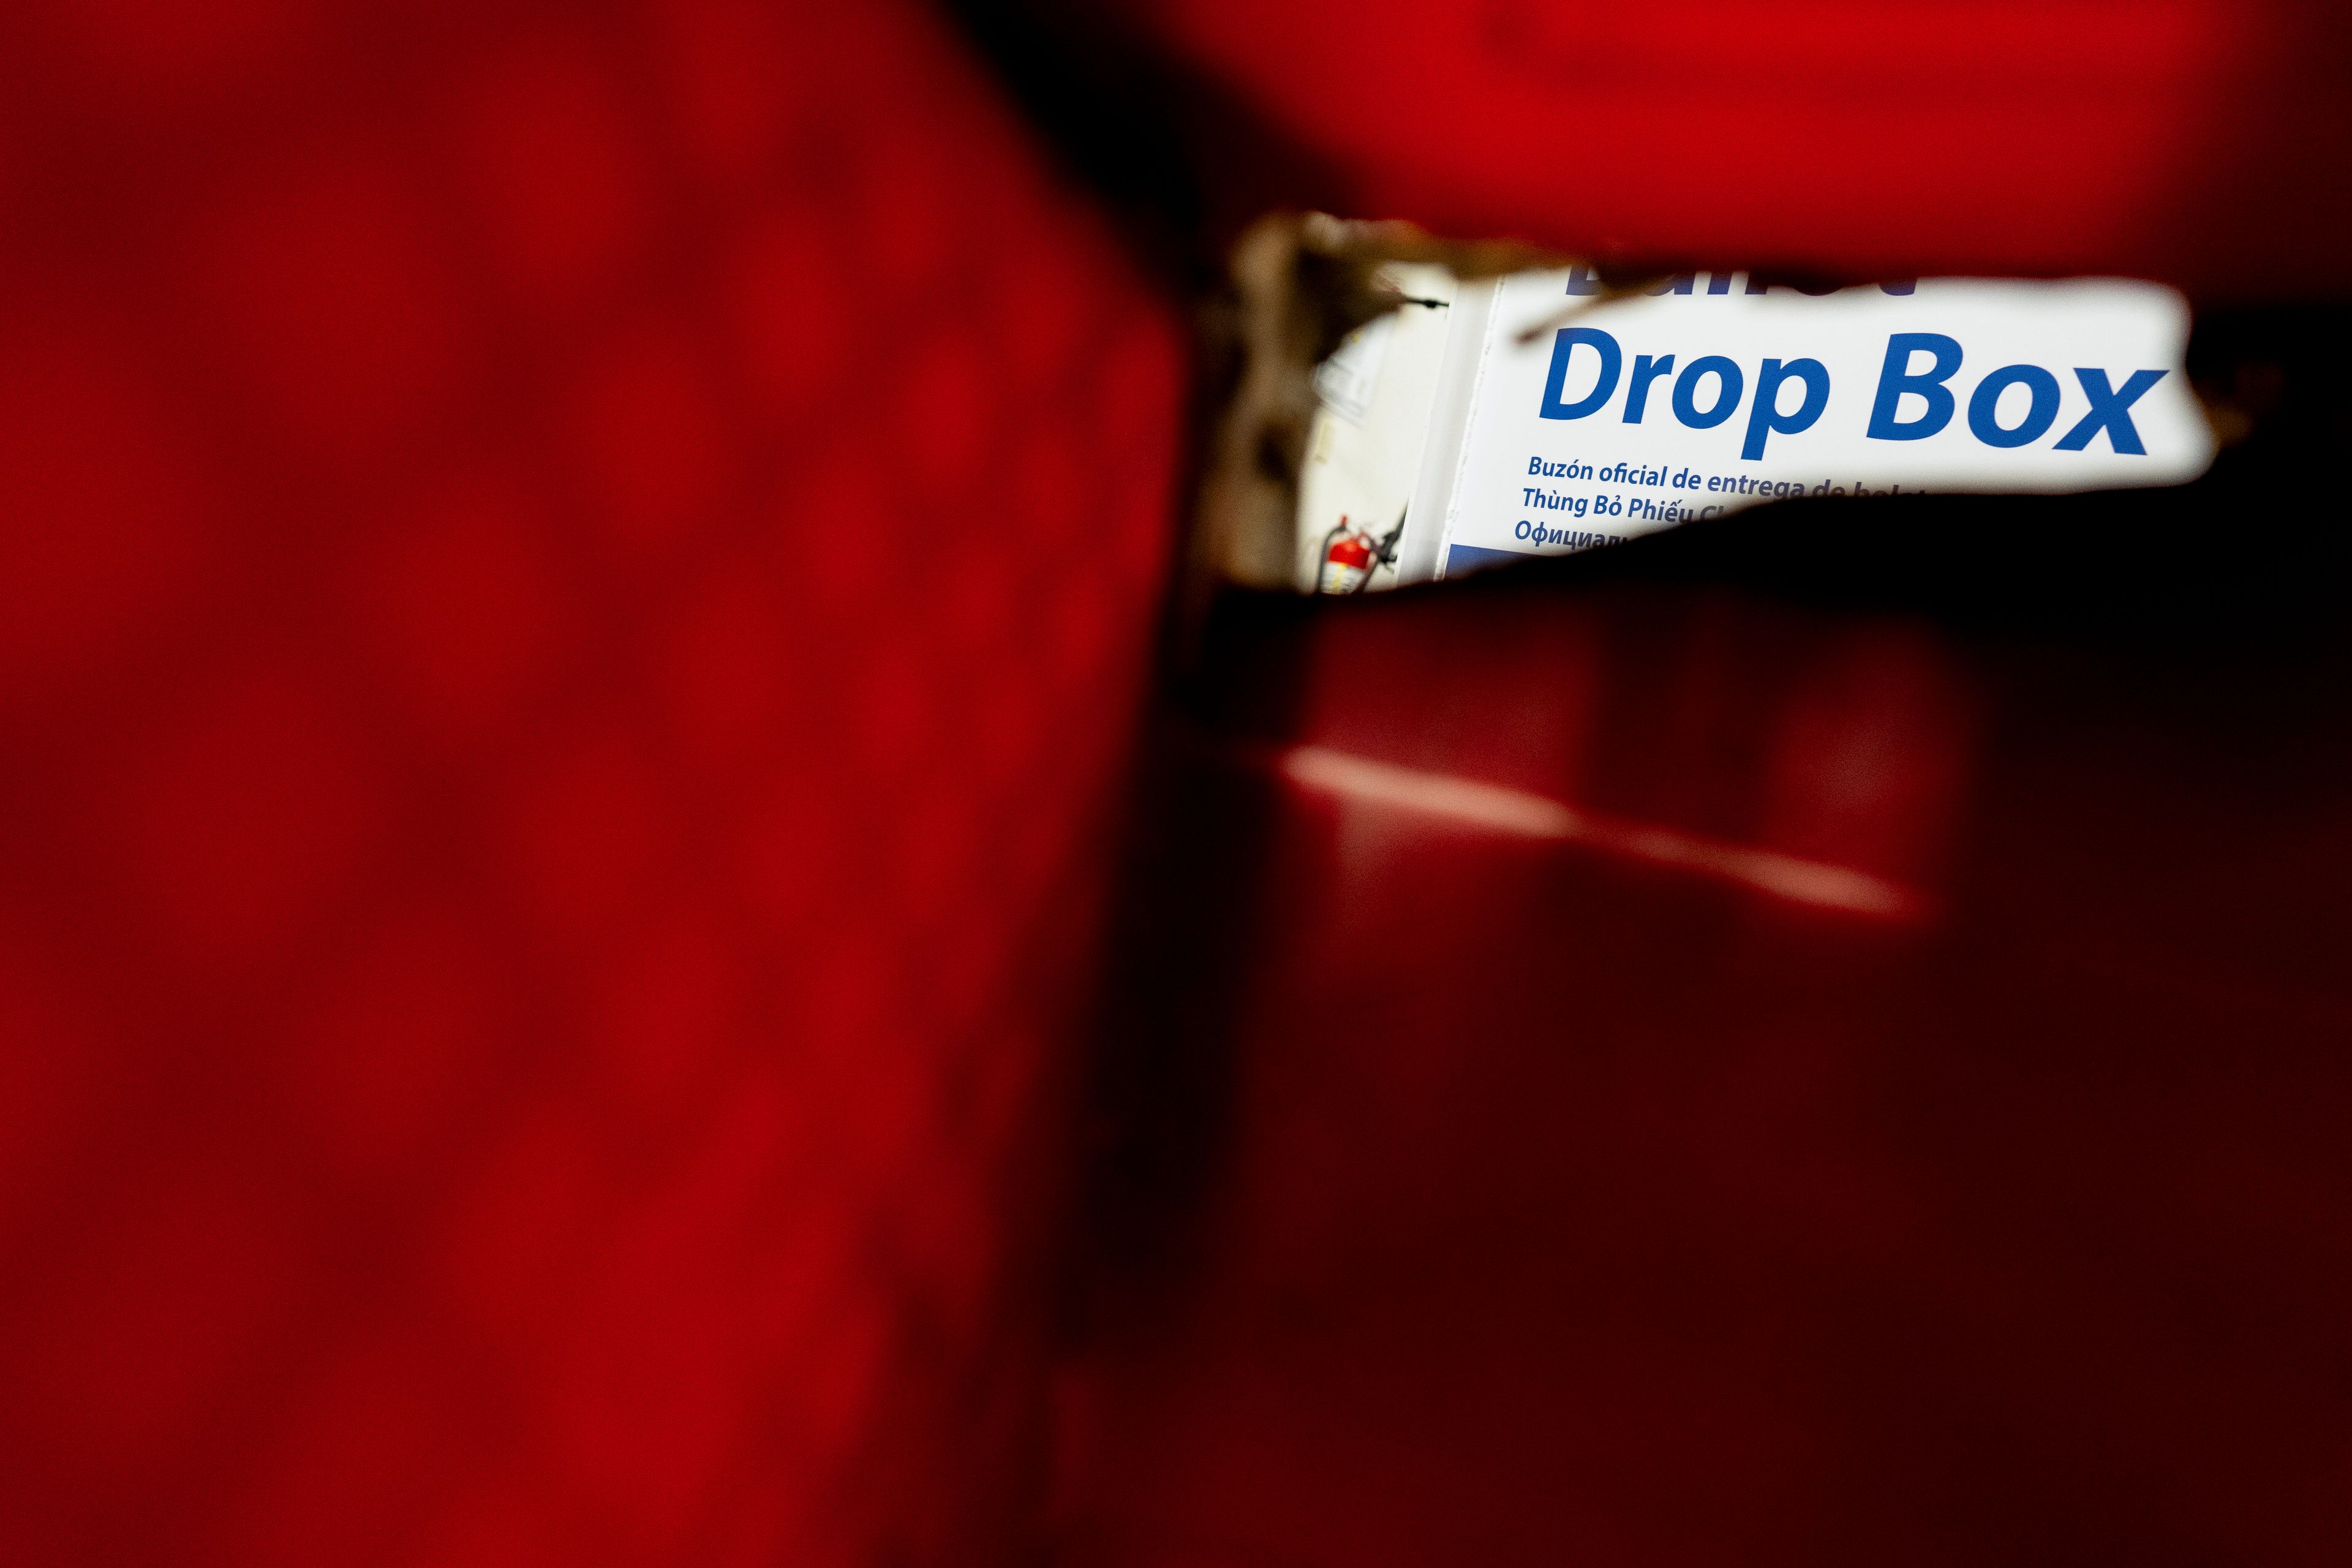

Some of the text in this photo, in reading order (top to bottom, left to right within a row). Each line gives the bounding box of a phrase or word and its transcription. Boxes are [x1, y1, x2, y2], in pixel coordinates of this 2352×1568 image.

[1539, 327, 2169, 461] Drop Box
[1528, 456, 1593, 480] Buzón
[1599, 462, 1668, 487] oficial
[1672, 468, 1702, 489] de
[1708, 475, 1804, 500] entrega
[1523, 488, 1588, 518] Thùng
[1593, 495, 1623, 516] Bỏ
[1627, 499, 1694, 522] Phiếu
